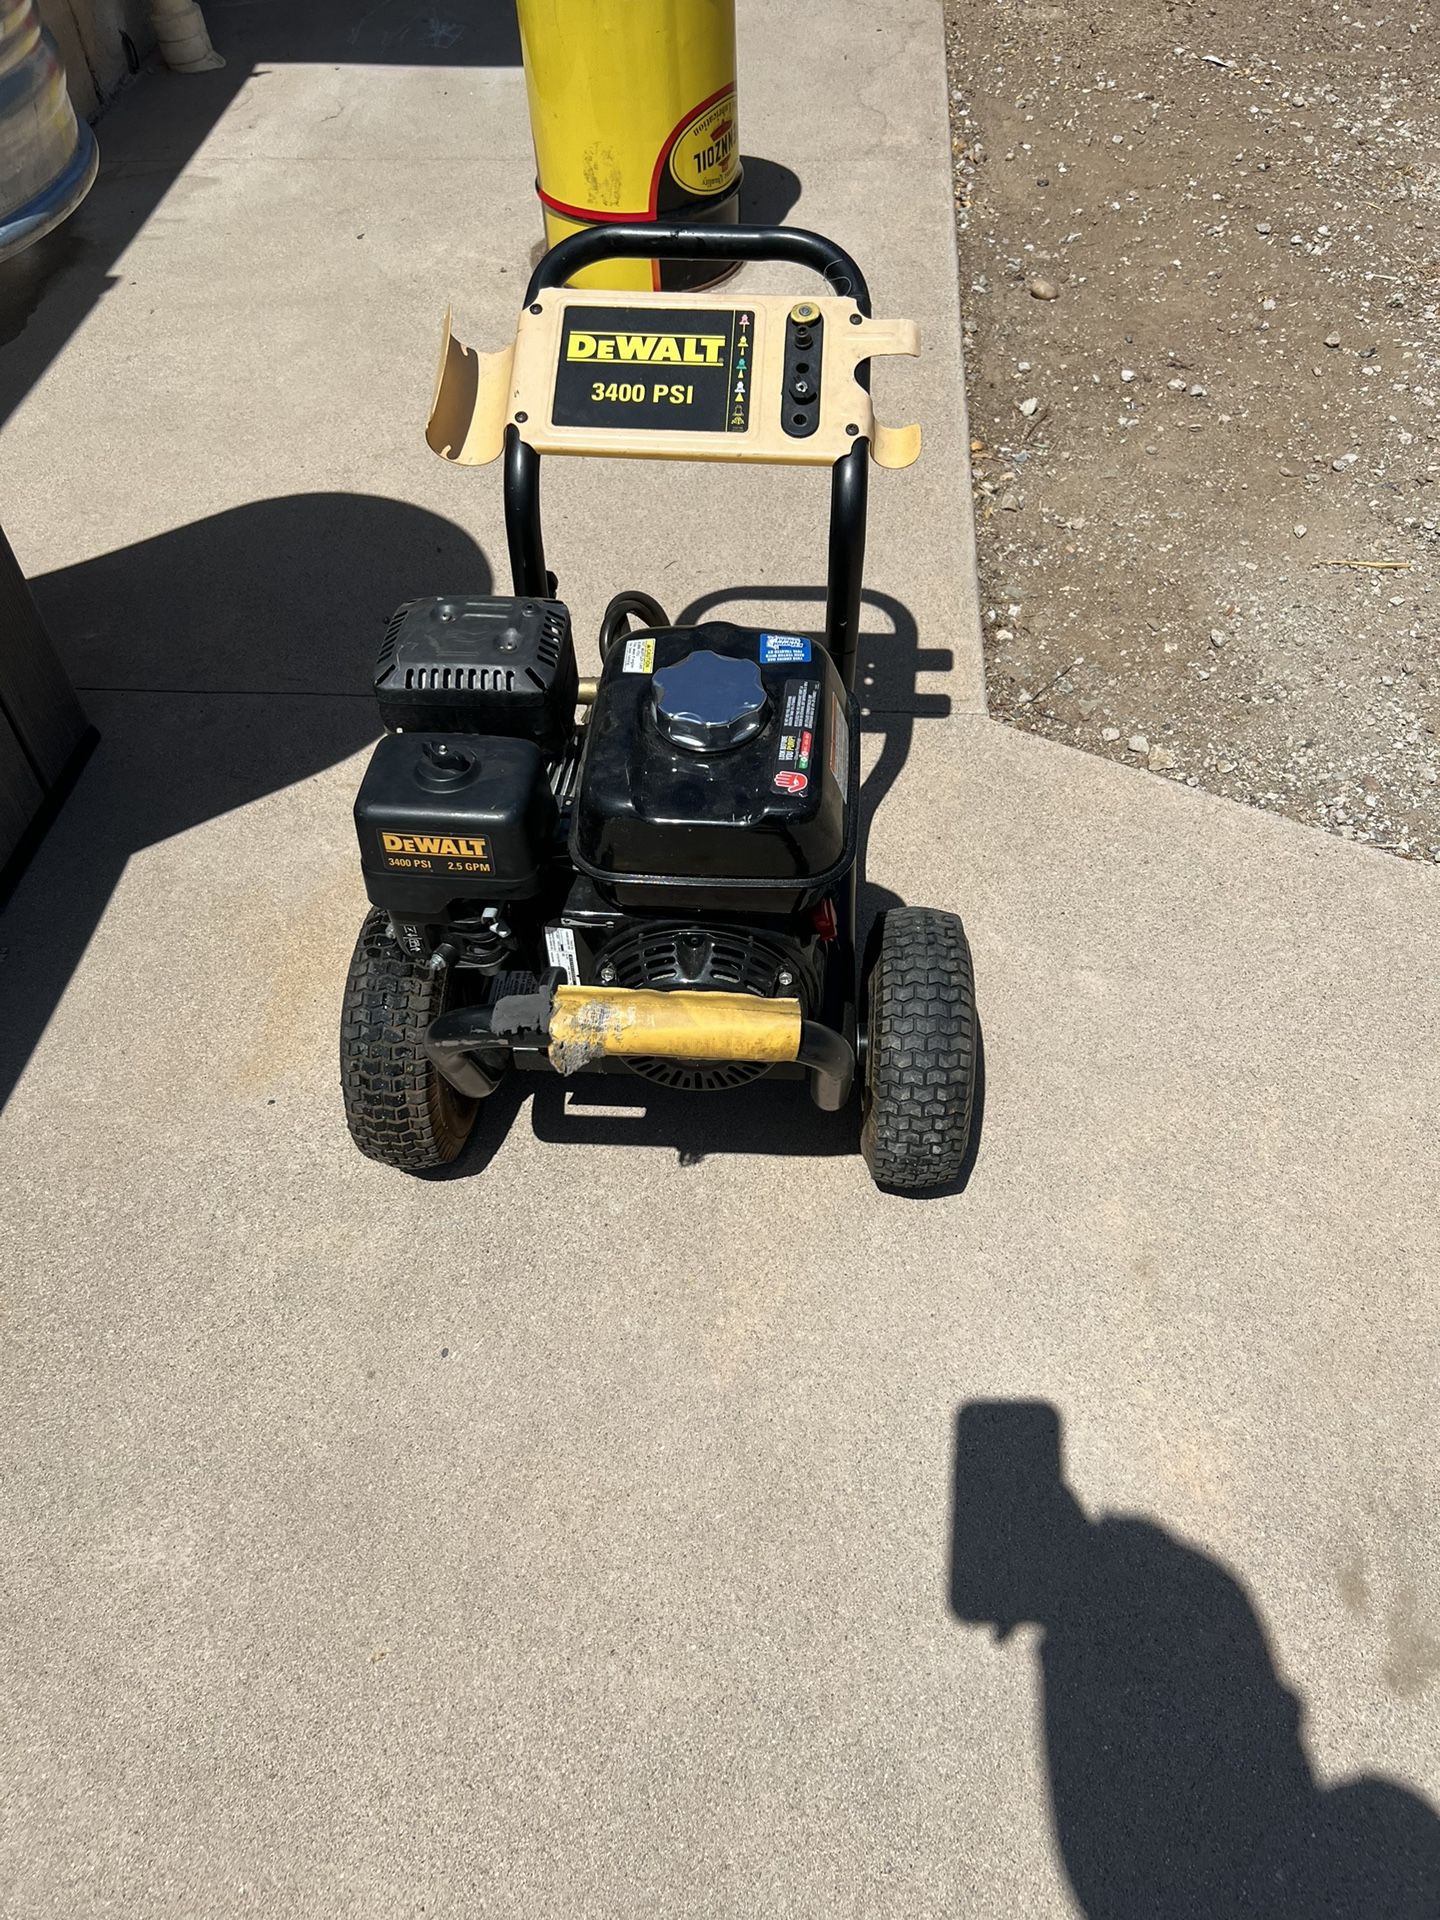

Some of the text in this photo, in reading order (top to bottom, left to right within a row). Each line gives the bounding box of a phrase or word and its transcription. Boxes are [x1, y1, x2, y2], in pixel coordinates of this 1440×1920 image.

[591, 382, 693, 405] 3400 PSI
[388, 857, 491, 872] 3400 PSI 2.5 GPM
